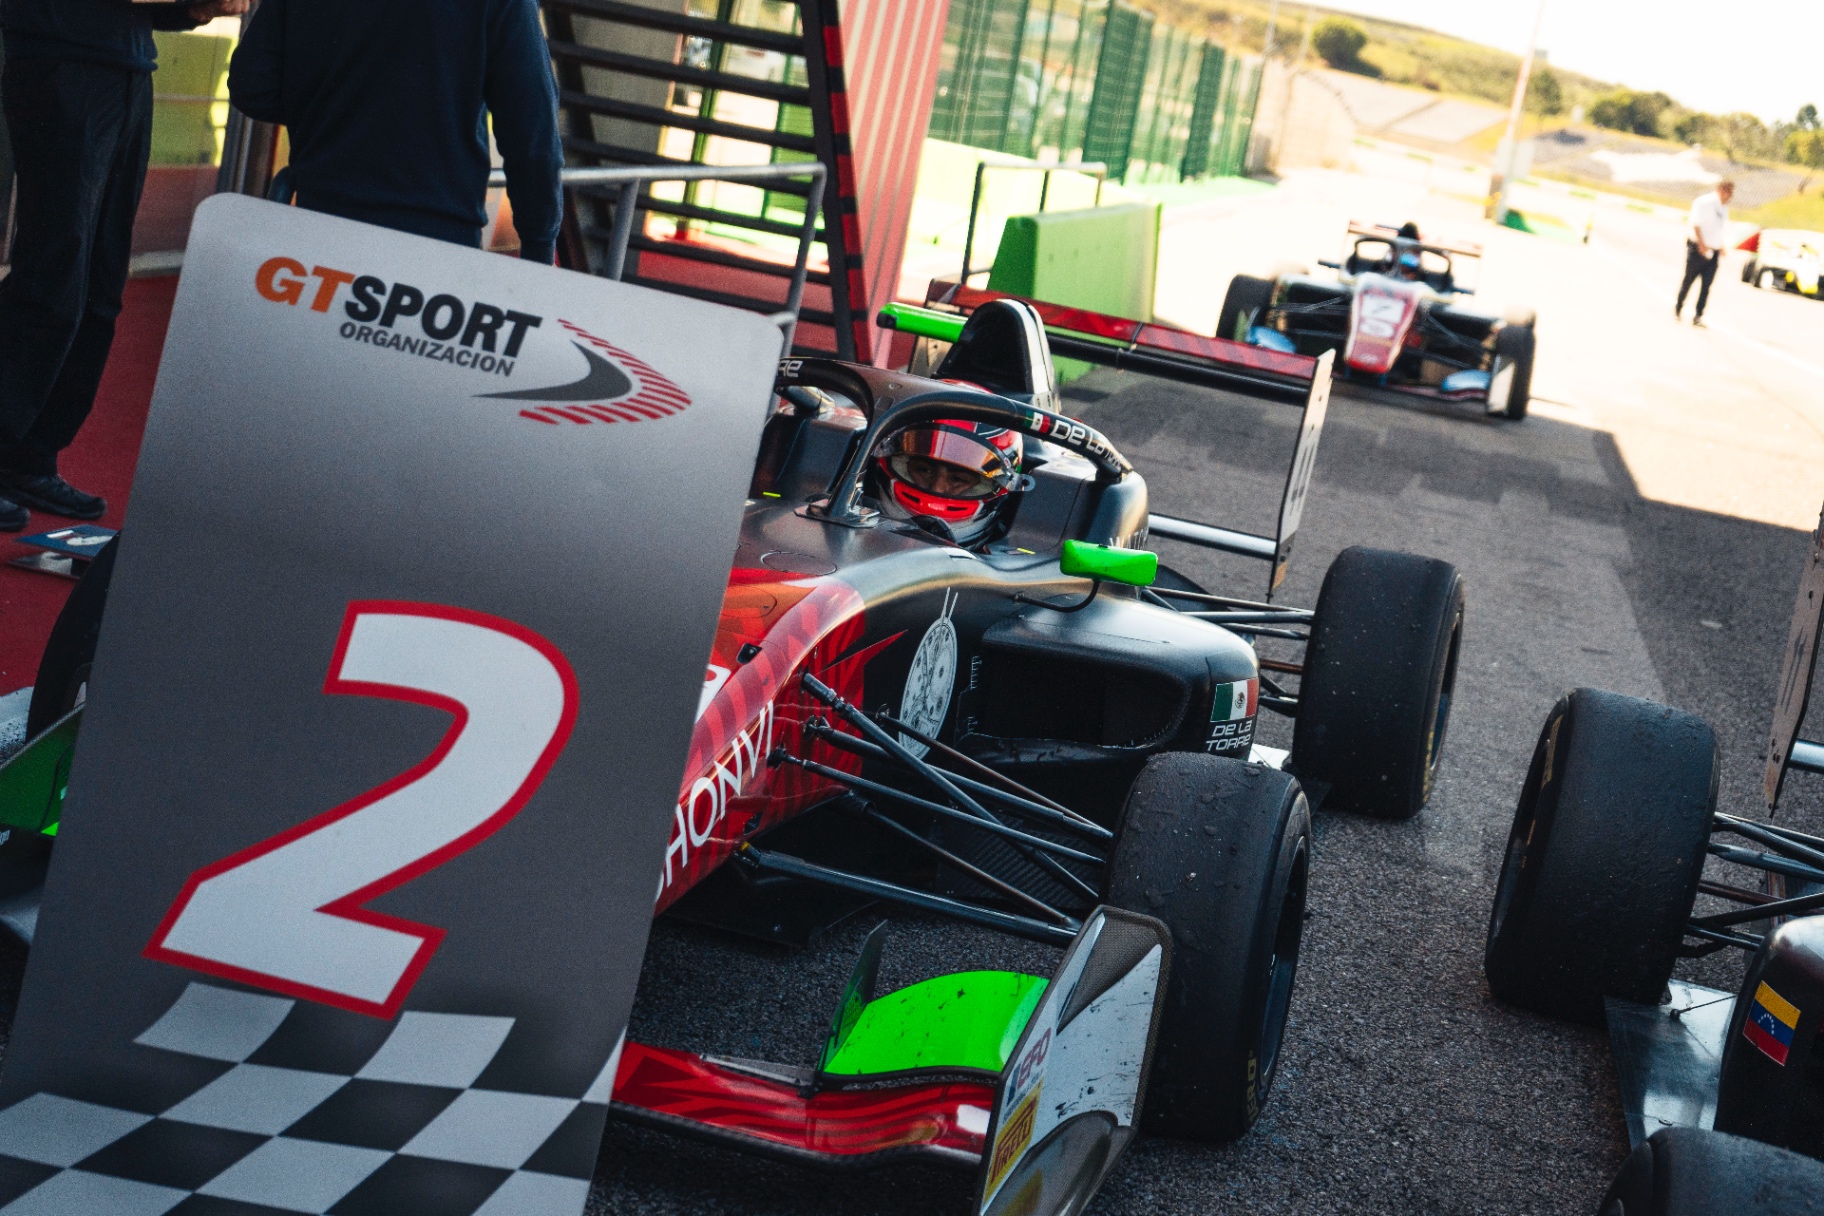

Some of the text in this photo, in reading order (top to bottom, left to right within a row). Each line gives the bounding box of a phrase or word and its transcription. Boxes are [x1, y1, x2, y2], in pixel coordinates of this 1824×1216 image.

[339, 321, 516, 377] ORGANIZACION
[141, 600, 580, 1021] 2
[654, 699, 774, 902] HONVI
